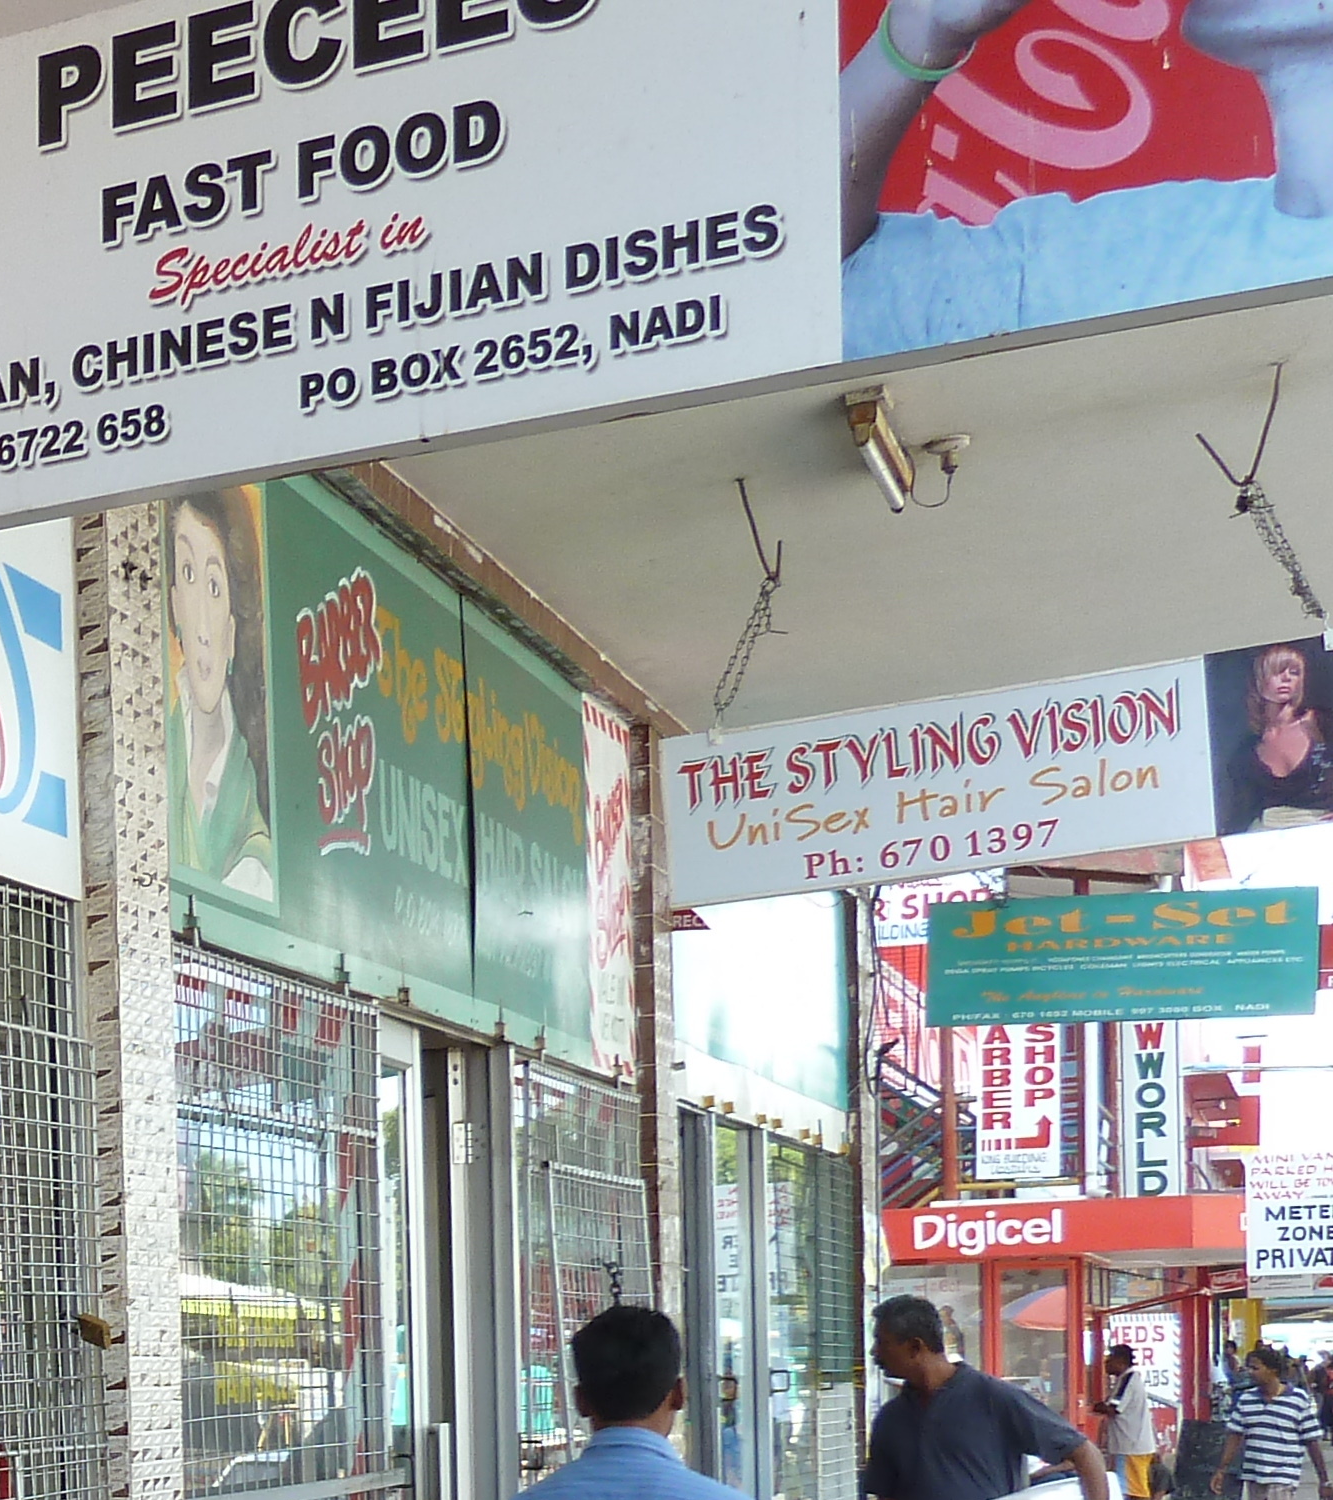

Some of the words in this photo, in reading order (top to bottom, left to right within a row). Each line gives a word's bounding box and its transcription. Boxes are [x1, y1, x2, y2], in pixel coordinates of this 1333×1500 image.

[37, 0, 599, 150] PEECEE
[100, 149, 273, 245] FAST
[296, 99, 503, 200] FOOD
[71, 302, 294, 389] CHINESE
[309, 293, 347, 346] N
[364, 250, 545, 331] FIJIAN
[565, 203, 782, 290] DISHES
[148, 224, 366, 307] Specialist
[380, 211, 428, 252] in
[298, 366, 357, 410] PO
[371, 345, 463, 397] BOX
[473, 323, 593, 376] 2652,
[608, 294, 723, 351] NADI
[95, 404, 167, 449] 658
[677, 744, 778, 817] THE
[785, 708, 1000, 795] STYLING
[1004, 677, 1181, 770] VISION
[897, 778, 1006, 826] Hair
[1029, 757, 1160, 804] Salon
[379, 758, 468, 889] UNISEX
[803, 848, 866, 880] Ph:
[879, 834, 951, 869] 670
[966, 818, 1061, 859] 1397
[1006, 932, 1236, 953] HARDWARE
[1071, 1008, 1125, 1017] MOBILE
[1234, 1003, 1270, 1012] NADI
[1023, 1022, 1056, 1108] SHOP
[912, 1208, 1064, 1257] Digicel
